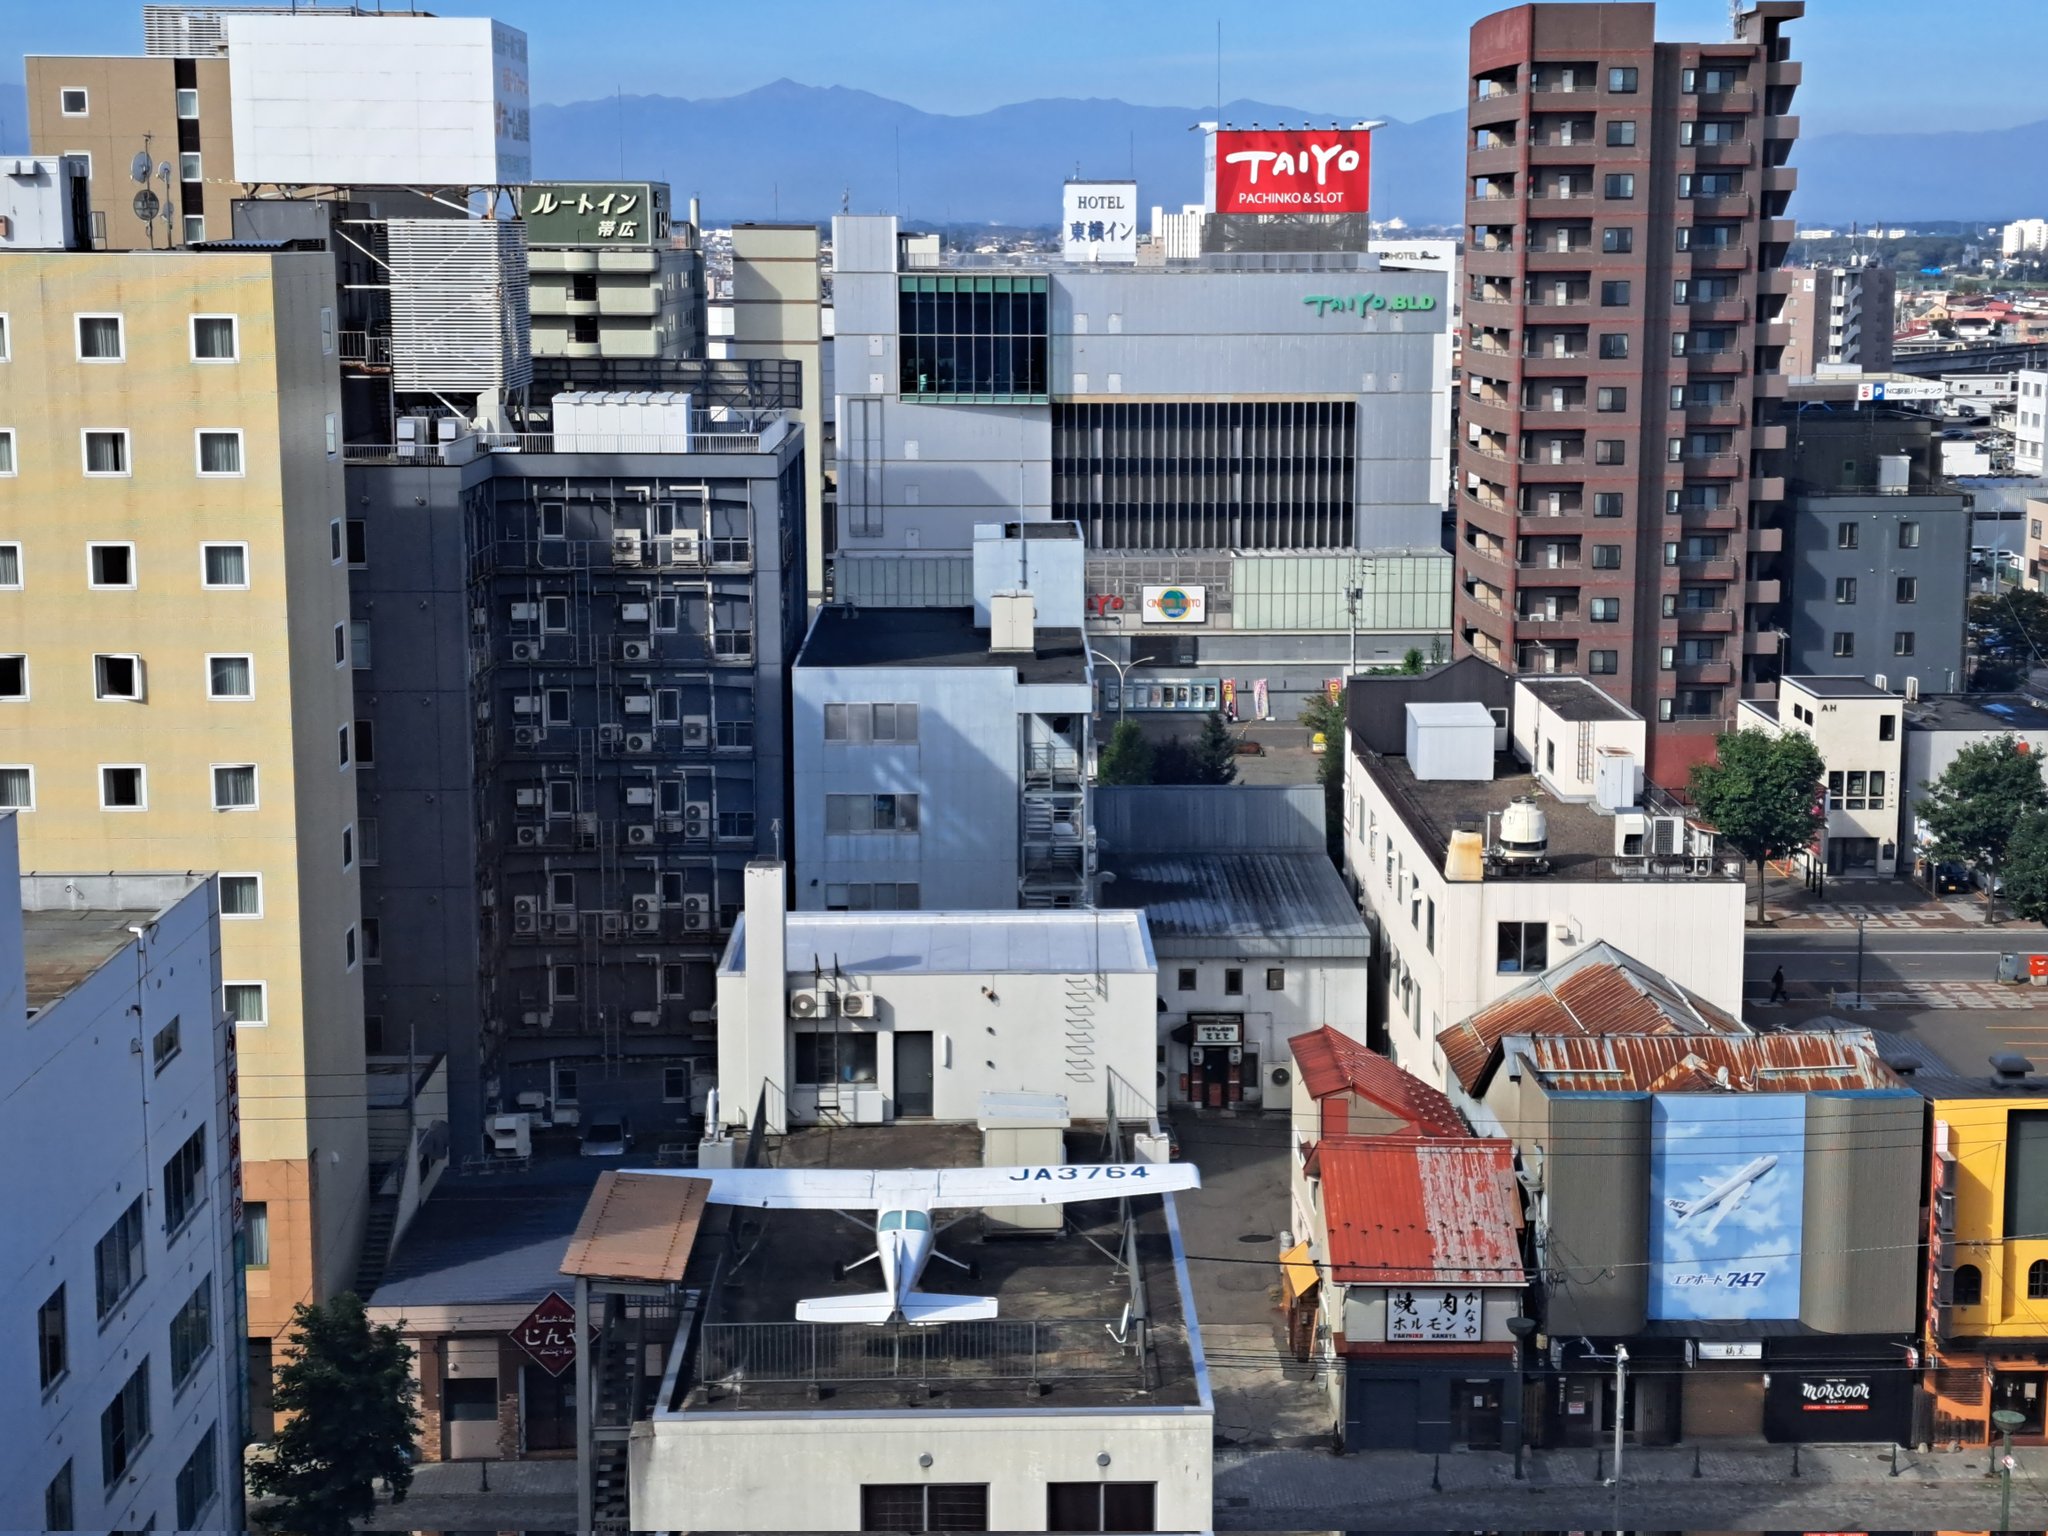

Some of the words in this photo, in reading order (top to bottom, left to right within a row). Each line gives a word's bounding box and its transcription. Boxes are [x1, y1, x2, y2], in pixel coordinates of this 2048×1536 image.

[1225, 144, 1360, 186] TAIYO
[531, 193, 637, 215] ルートイン
[1078, 196, 1125, 209] HOTEL
[1239, 193, 1301, 204] PACHINKO
[1313, 192, 1344, 203] SLOT
[598, 220, 637, 238] 帯広
[1069, 221, 1133, 242] 東横イン
[1875, 387, 1883, 397] P
[1009, 1166, 1150, 1181] JA3764
[1668, 1200, 1686, 1209] 747
[1726, 1272, 1767, 1288] 747
[1464, 1291, 1478, 1339] かなや
[1393, 1317, 1457, 1331] ホルモン
